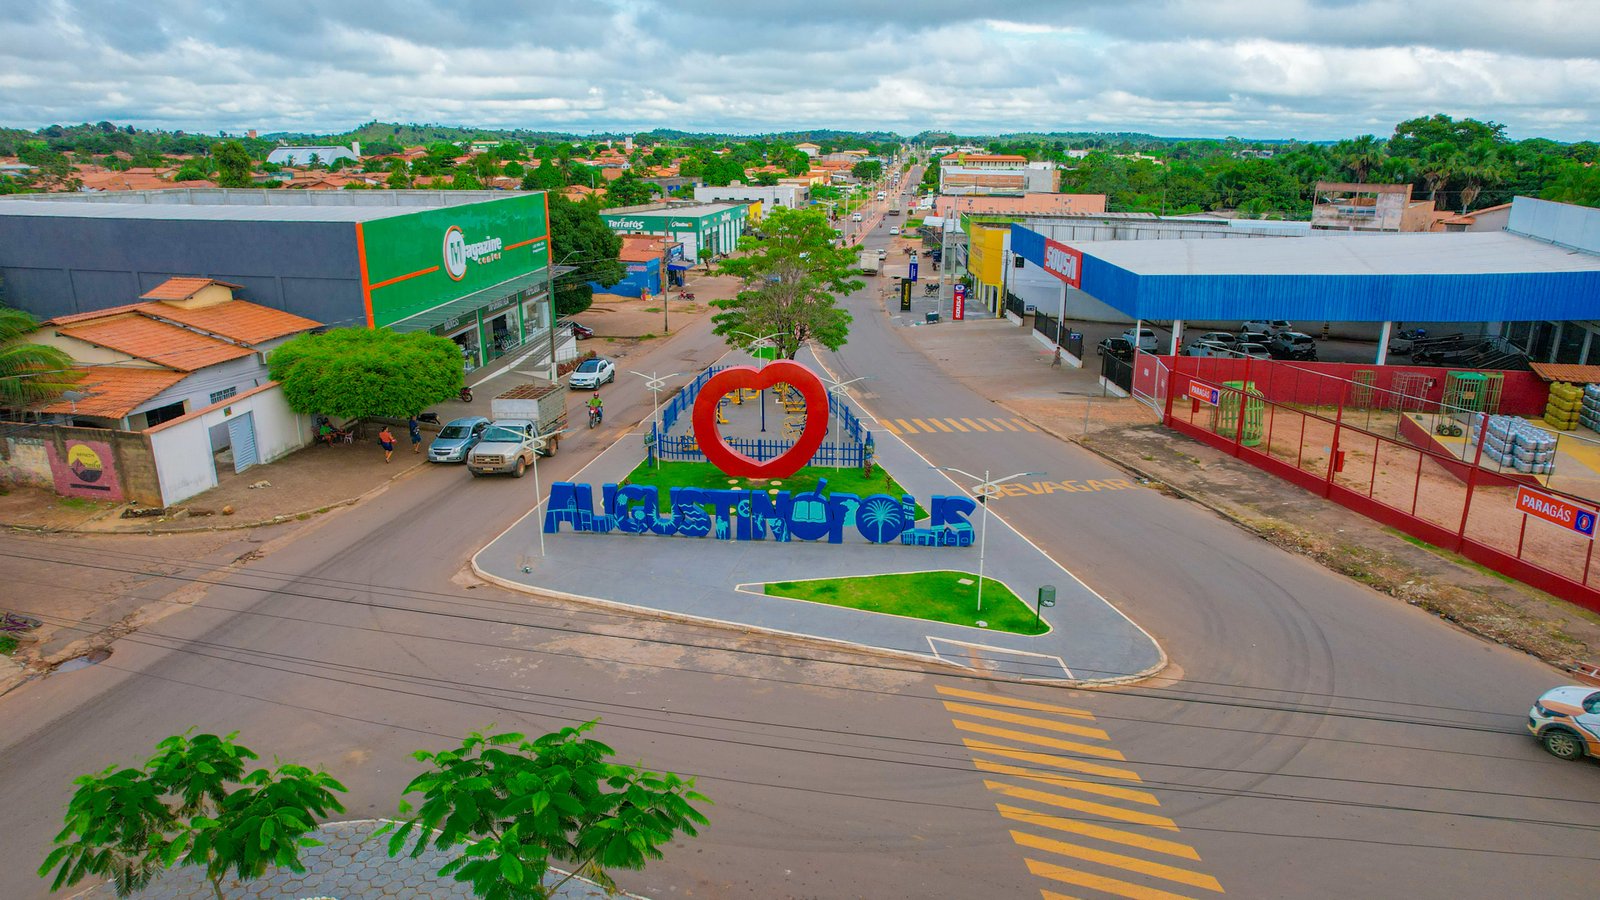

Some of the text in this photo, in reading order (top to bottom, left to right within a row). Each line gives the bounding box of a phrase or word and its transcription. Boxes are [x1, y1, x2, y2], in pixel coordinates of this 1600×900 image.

[447, 232, 502, 270] Magazine
[477, 252, 502, 265] center
[1046, 246, 1077, 281] SOUSA
[544, 478, 976, 547] AUGUSTINÓPOLIS
[1522, 494, 1572, 522] PARAGÁS
